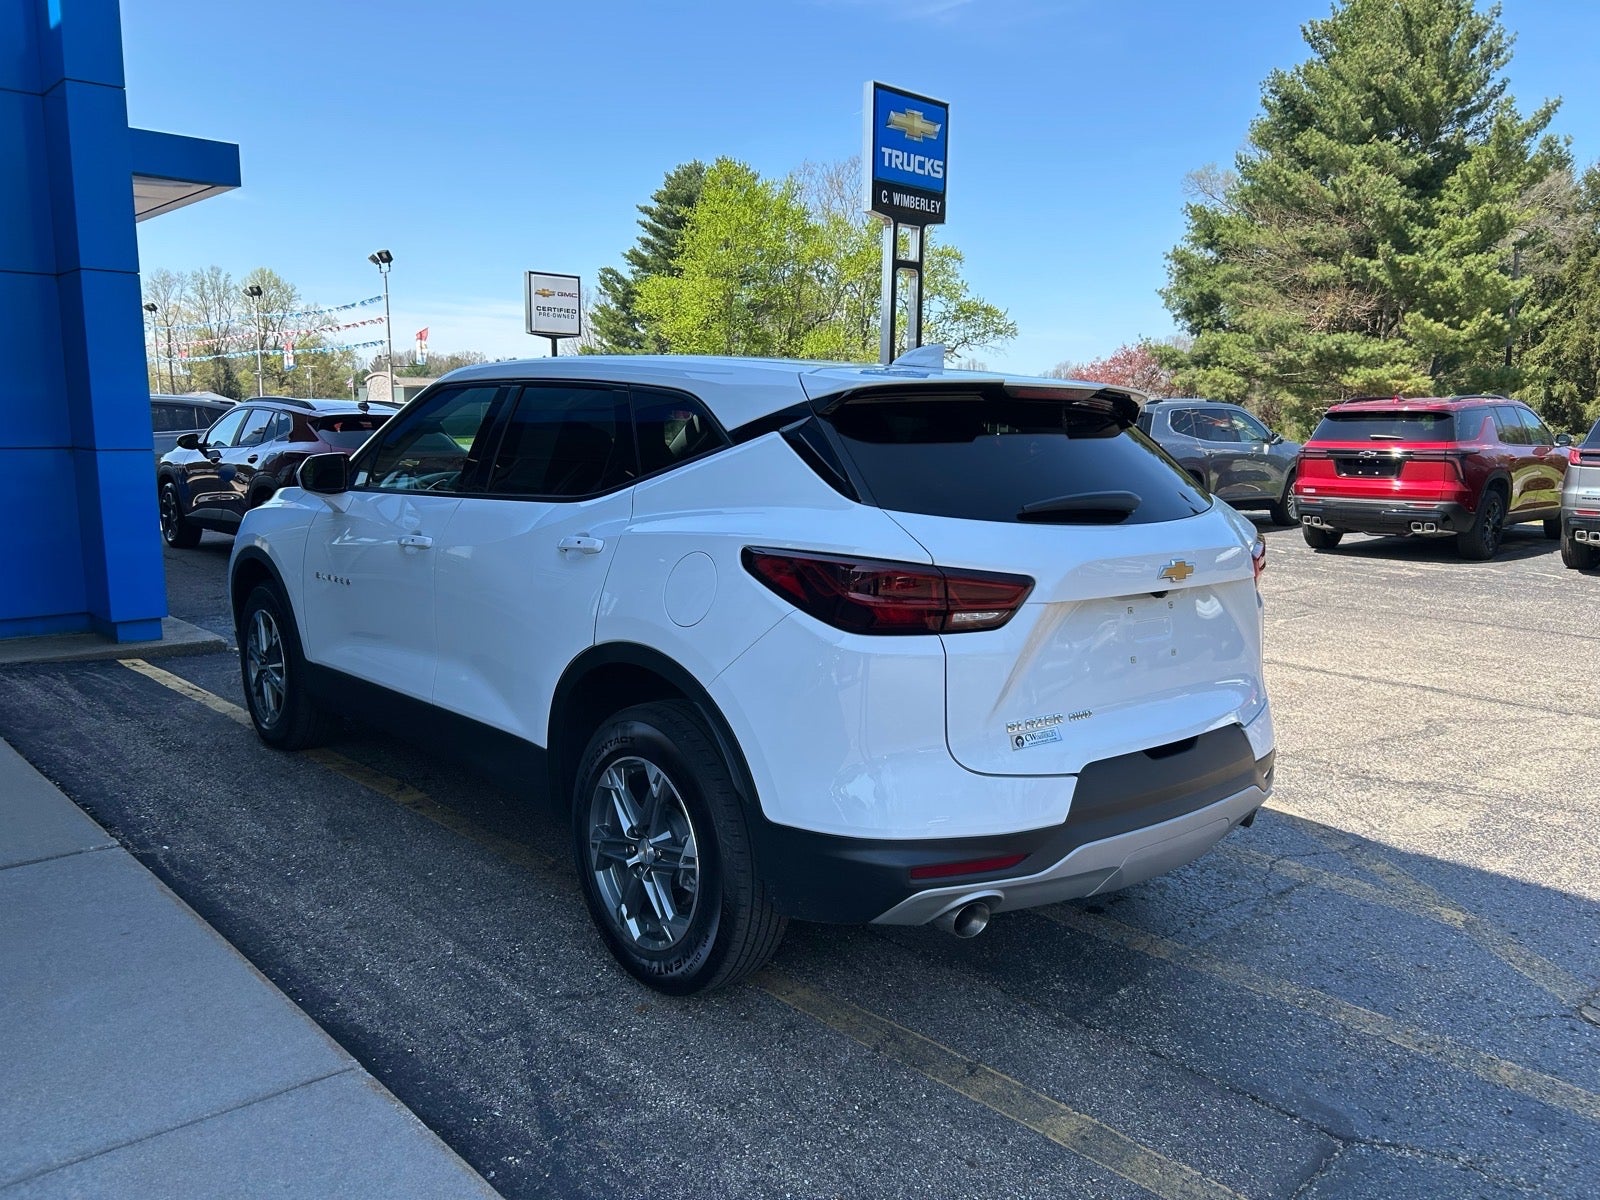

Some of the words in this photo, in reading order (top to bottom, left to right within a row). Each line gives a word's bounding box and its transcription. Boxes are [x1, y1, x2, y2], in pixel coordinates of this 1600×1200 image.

[882, 147, 943, 179] TRUCKS
[882, 190, 889, 204] C.
[893, 192, 941, 214] WIMBERLEY
[536, 306, 577, 314] CERTIFIED
[538, 312, 575, 320] PRE-OWNED
[1006, 713, 1063, 733] BLAZER
